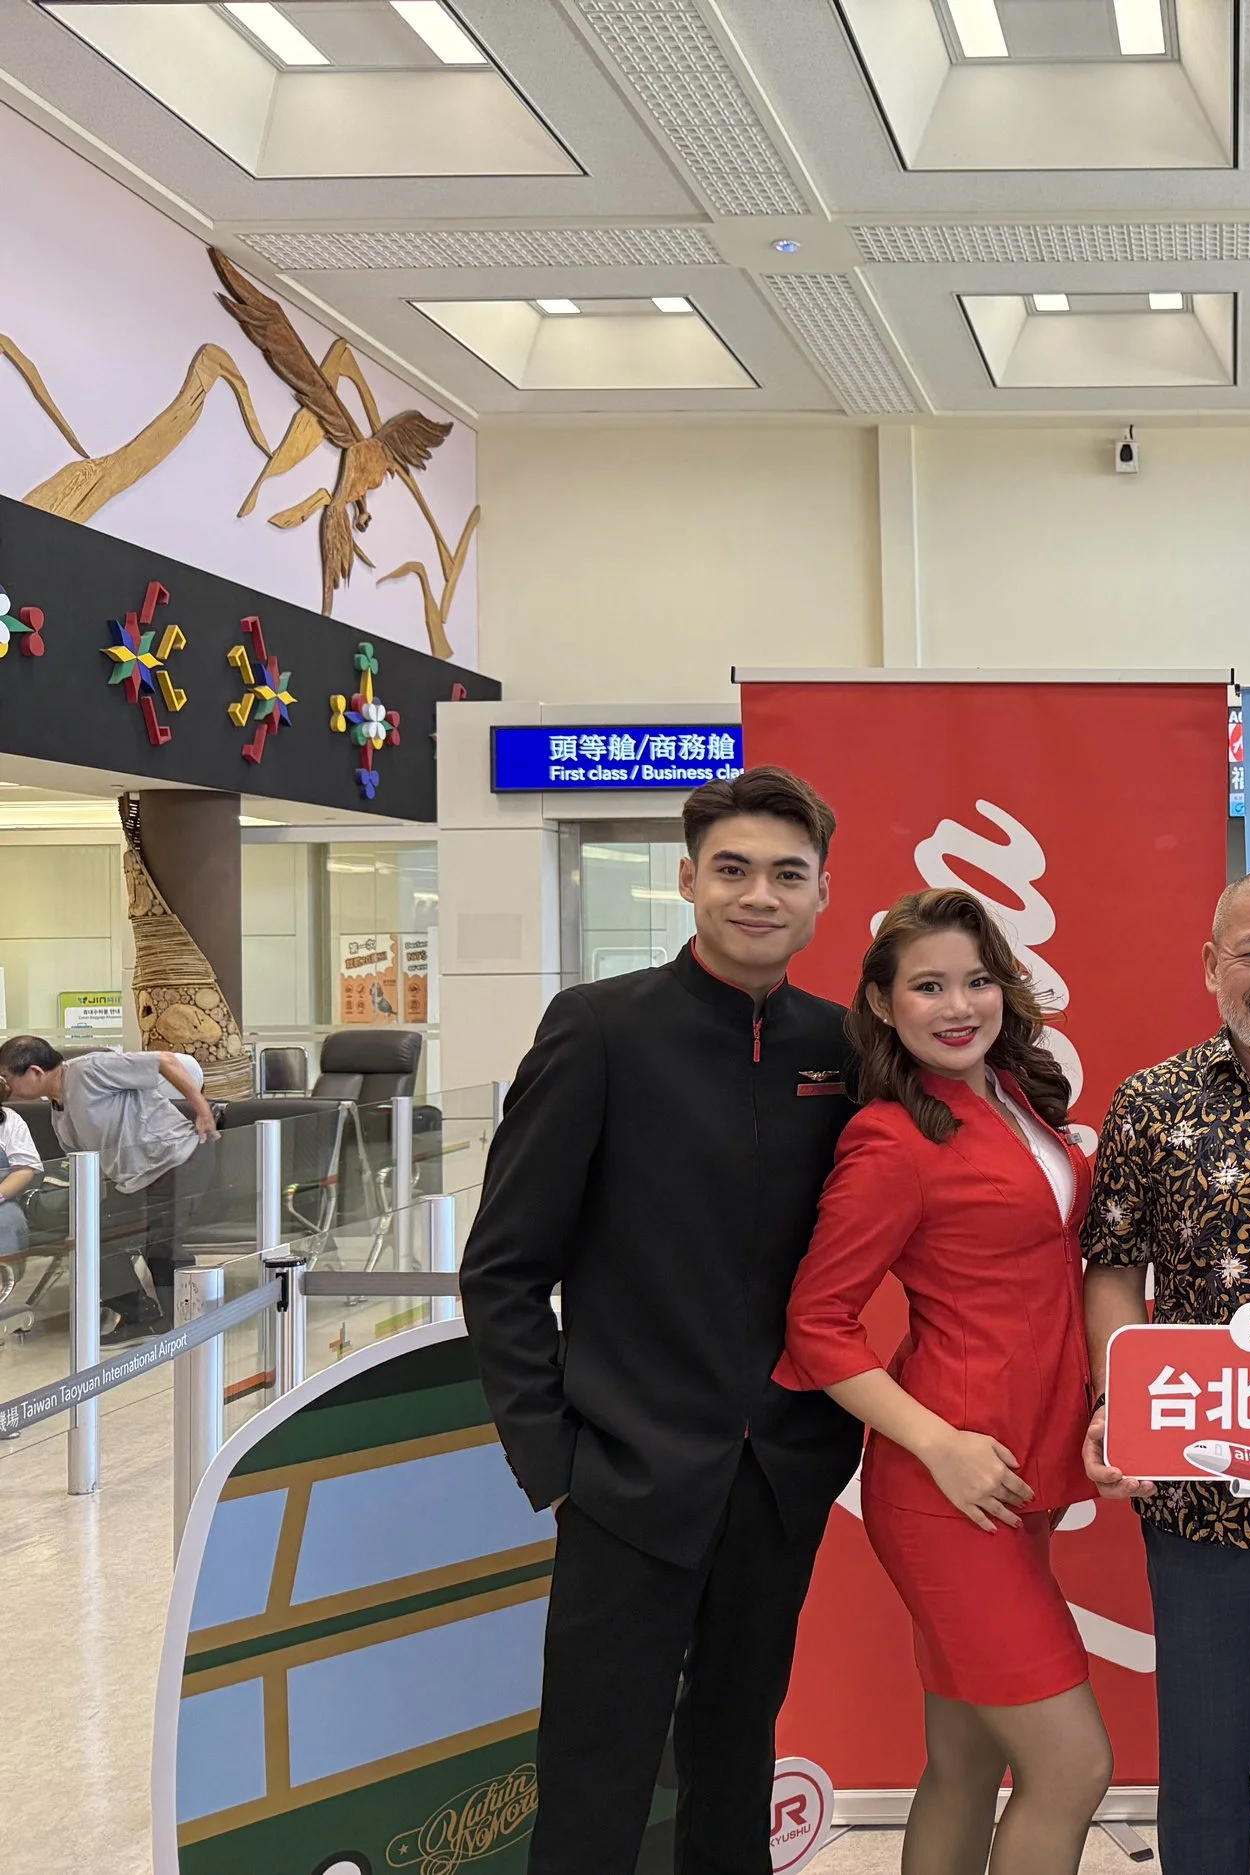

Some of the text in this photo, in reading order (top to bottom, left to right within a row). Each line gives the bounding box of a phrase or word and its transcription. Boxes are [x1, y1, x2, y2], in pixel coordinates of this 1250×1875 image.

[549, 733, 736, 762] 頭等艙/商務艙
[549, 763, 745, 781] First class / Business cla
[21, 1394, 58, 1419] Taiwan
[60, 1374, 101, 1402] Taoyuan
[102, 1345, 157, 1385] International
[159, 1333, 188, 1358] Airport
[770, 1793, 807, 1837] JR
